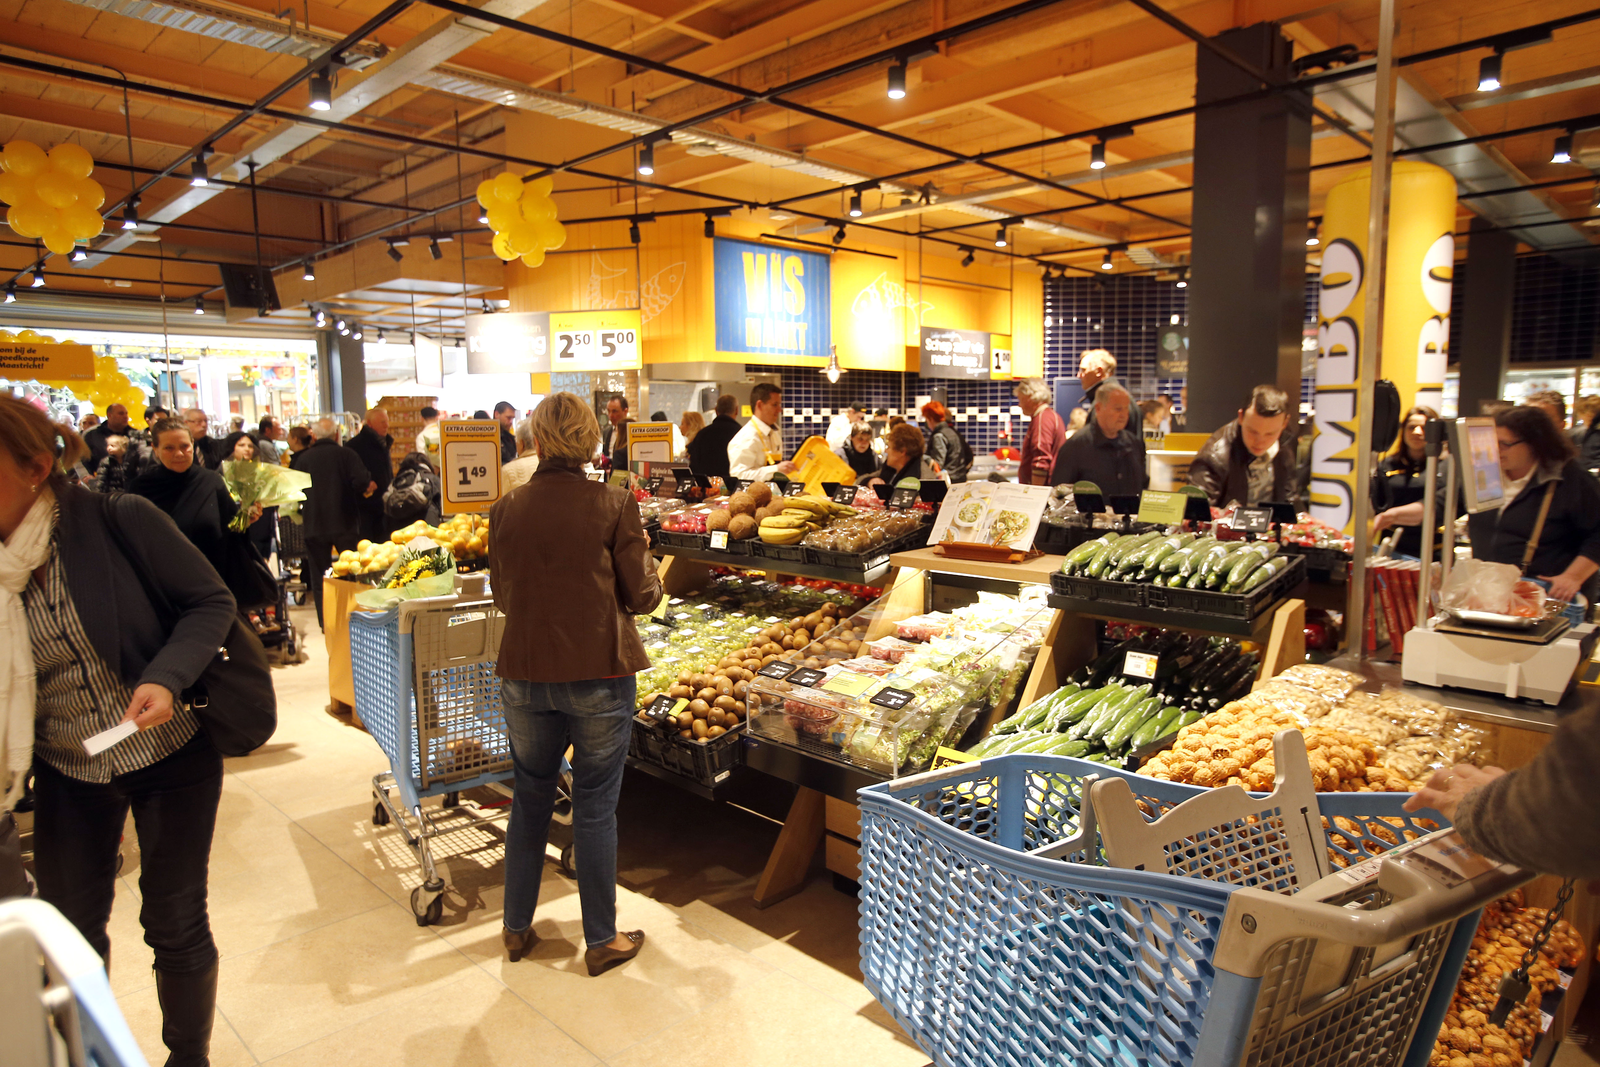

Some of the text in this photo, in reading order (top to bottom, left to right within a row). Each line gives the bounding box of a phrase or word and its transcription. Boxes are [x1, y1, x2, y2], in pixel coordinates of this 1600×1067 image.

[742, 251, 806, 316] VIS
[745, 317, 808, 350] MARKT
[15, 347, 25, 355] bij
